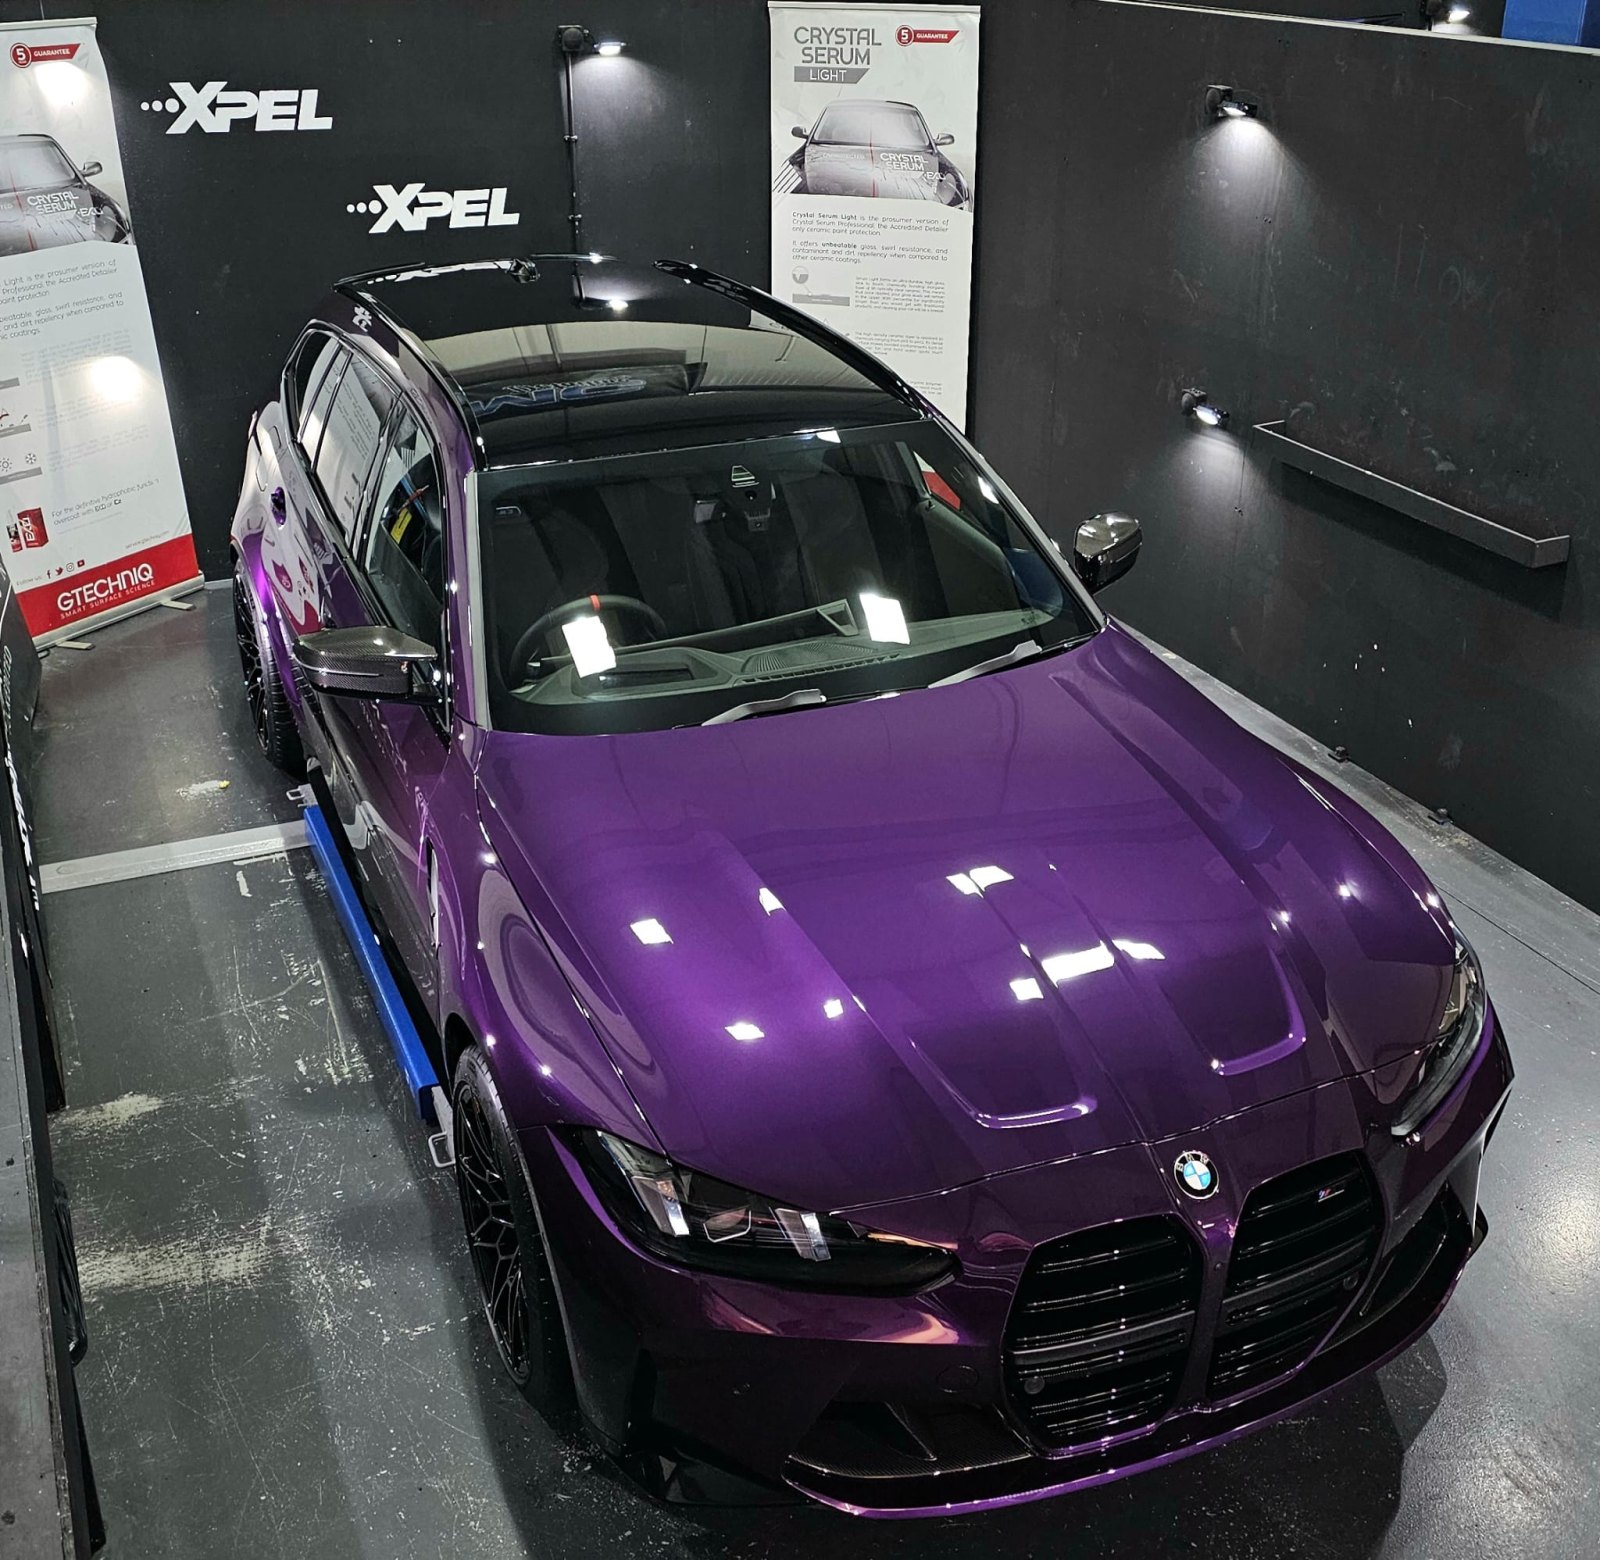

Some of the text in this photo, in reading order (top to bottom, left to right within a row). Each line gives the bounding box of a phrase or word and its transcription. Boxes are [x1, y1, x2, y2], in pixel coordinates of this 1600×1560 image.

[794, 26, 882, 46] CRYSTAL
[901, 29, 909, 40] 5
[16, 48, 71, 61] 5 GUARANTEE
[801, 47, 871, 66] SERUM
[809, 69, 847, 82] LIGHT
[165, 81, 333, 134] XPEL
[880, 152, 929, 164] CRYSTAL
[886, 161, 925, 171] SERUM
[27, 190, 79, 206] CRYSTAL
[36, 200, 77, 214] SERUM
[368, 182, 520, 235] XPEL
[4, 276, 24, 286] Light
[57, 563, 154, 612] GTECHNIQ
[60, 580, 156, 620] SMART SURFACE SCIENCE
